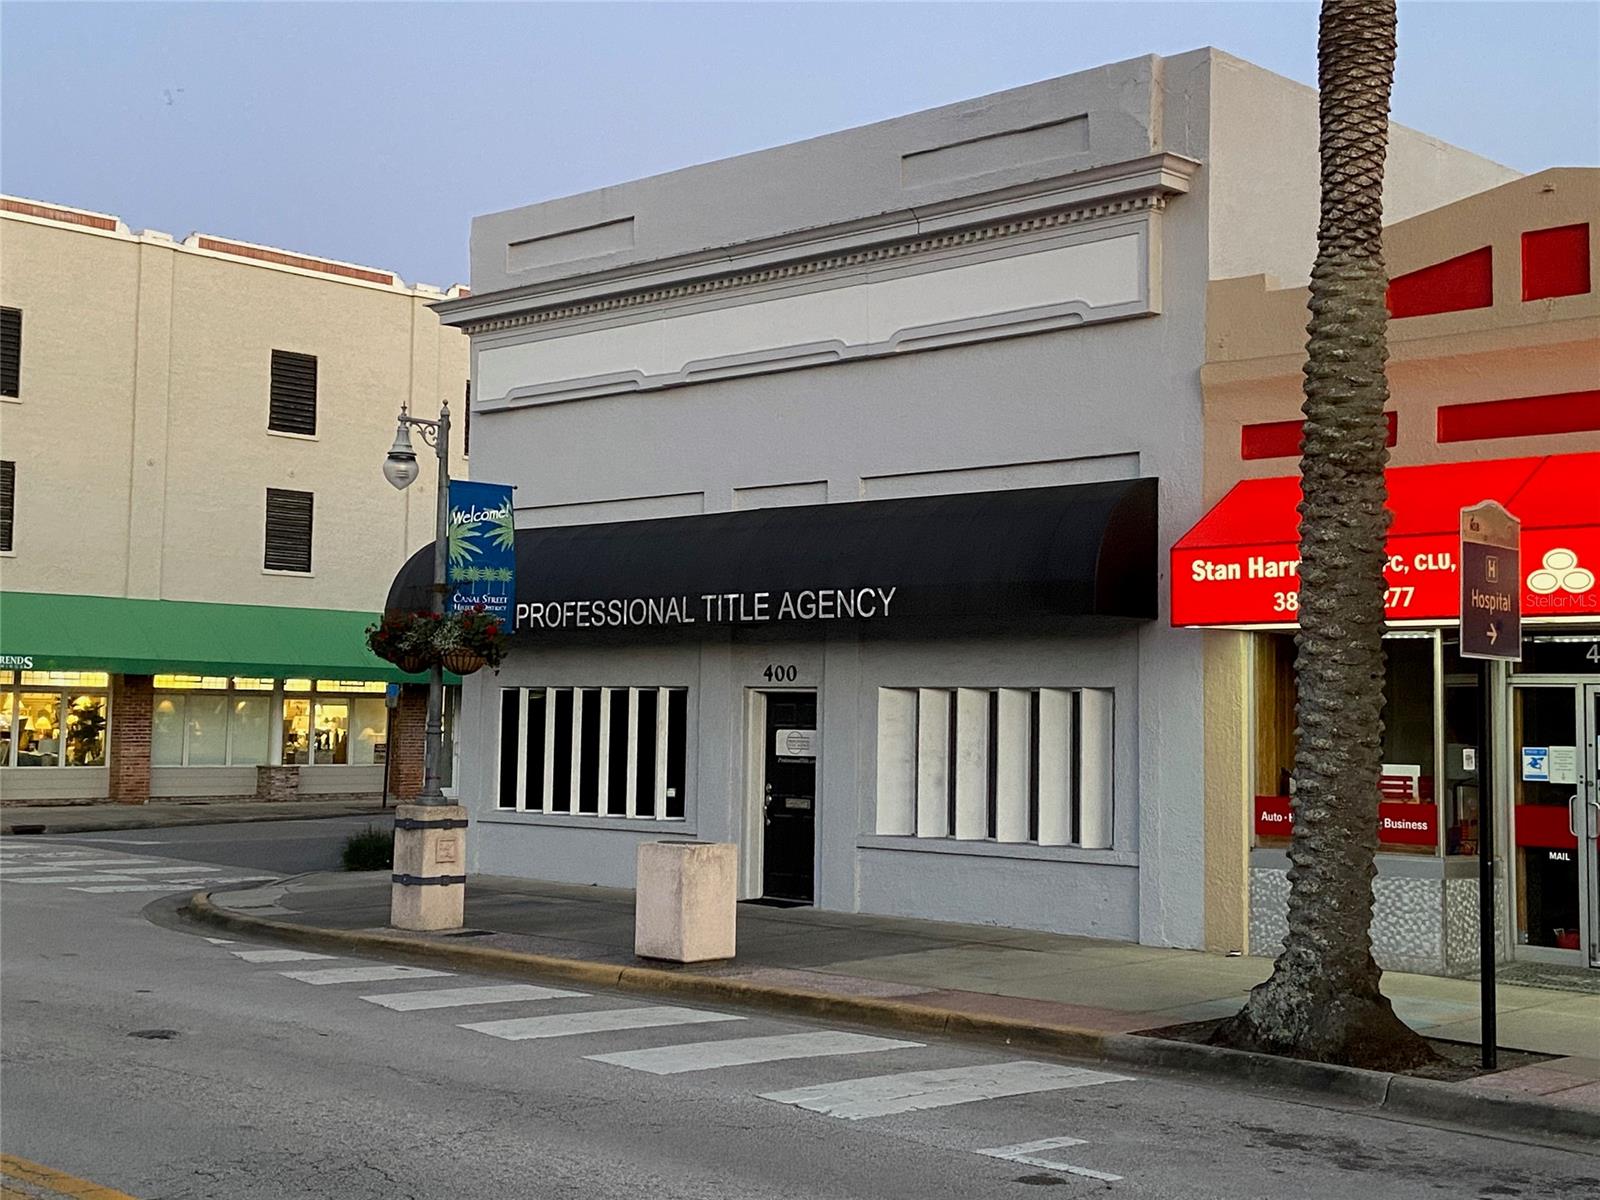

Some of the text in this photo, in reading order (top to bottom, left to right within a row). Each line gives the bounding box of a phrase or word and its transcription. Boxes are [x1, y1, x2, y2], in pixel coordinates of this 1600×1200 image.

[452, 503, 509, 525] Welcome!
[1191, 559, 1241, 582] Stan
[1247, 556, 1302, 579] Harr
[1413, 552, 1456, 573] CLU,
[515, 586, 897, 629] PROFESSIONAL TITLE AGENCY
[1471, 588, 1511, 616] Hospital
[763, 664, 798, 682] 400
[1261, 811, 1283, 823] Auto
[1384, 818, 1428, 831] Business
[1548, 851, 1571, 862] MAIL
